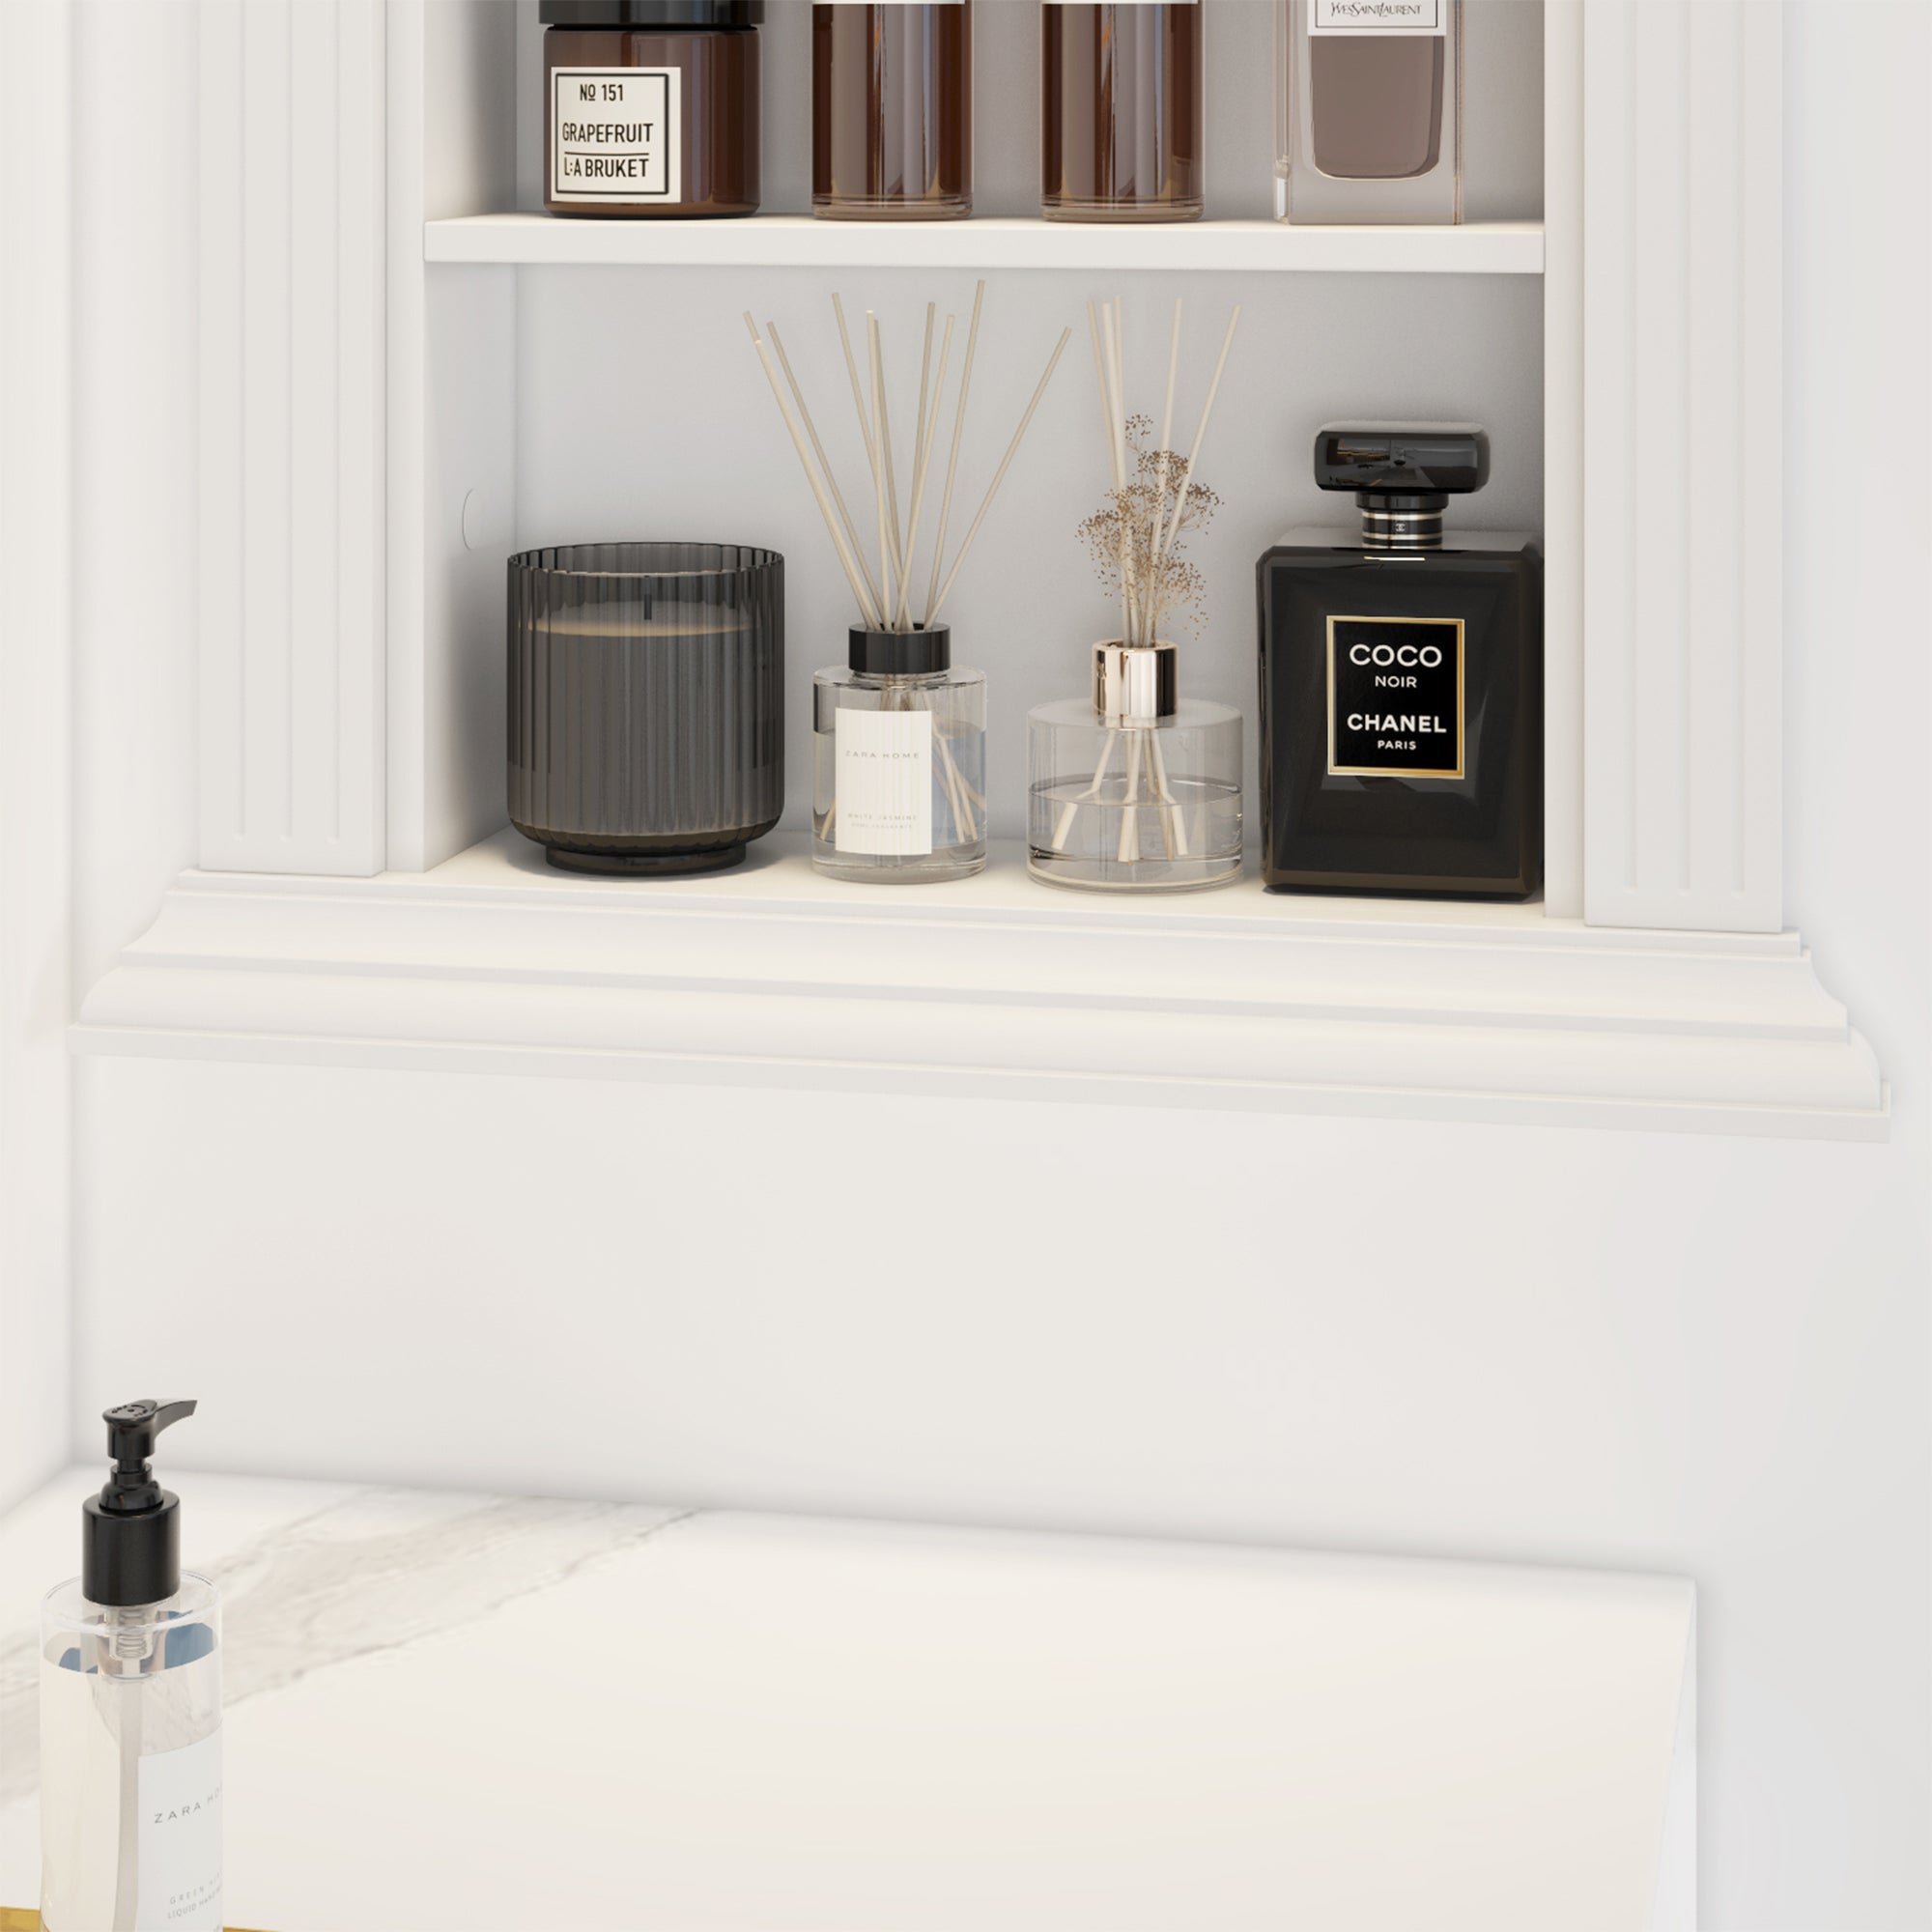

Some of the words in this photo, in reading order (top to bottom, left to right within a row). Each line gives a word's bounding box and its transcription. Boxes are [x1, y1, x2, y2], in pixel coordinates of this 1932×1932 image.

[602, 84, 623, 101] 151
[562, 123, 653, 143] GRAPEFRUIT
[564, 157, 582, 176] L:A
[585, 158, 649, 178] BRUKET
[1350, 643, 1442, 668] COCO
[1375, 675, 1417, 688] NOIR
[1347, 713, 1447, 733] CHANEL
[845, 750, 876, 758] ZARA
[1378, 740, 1416, 751] PARIS
[154, 1802, 202, 1824] ZARA
[167, 1903, 197, 1919] LIQUID
